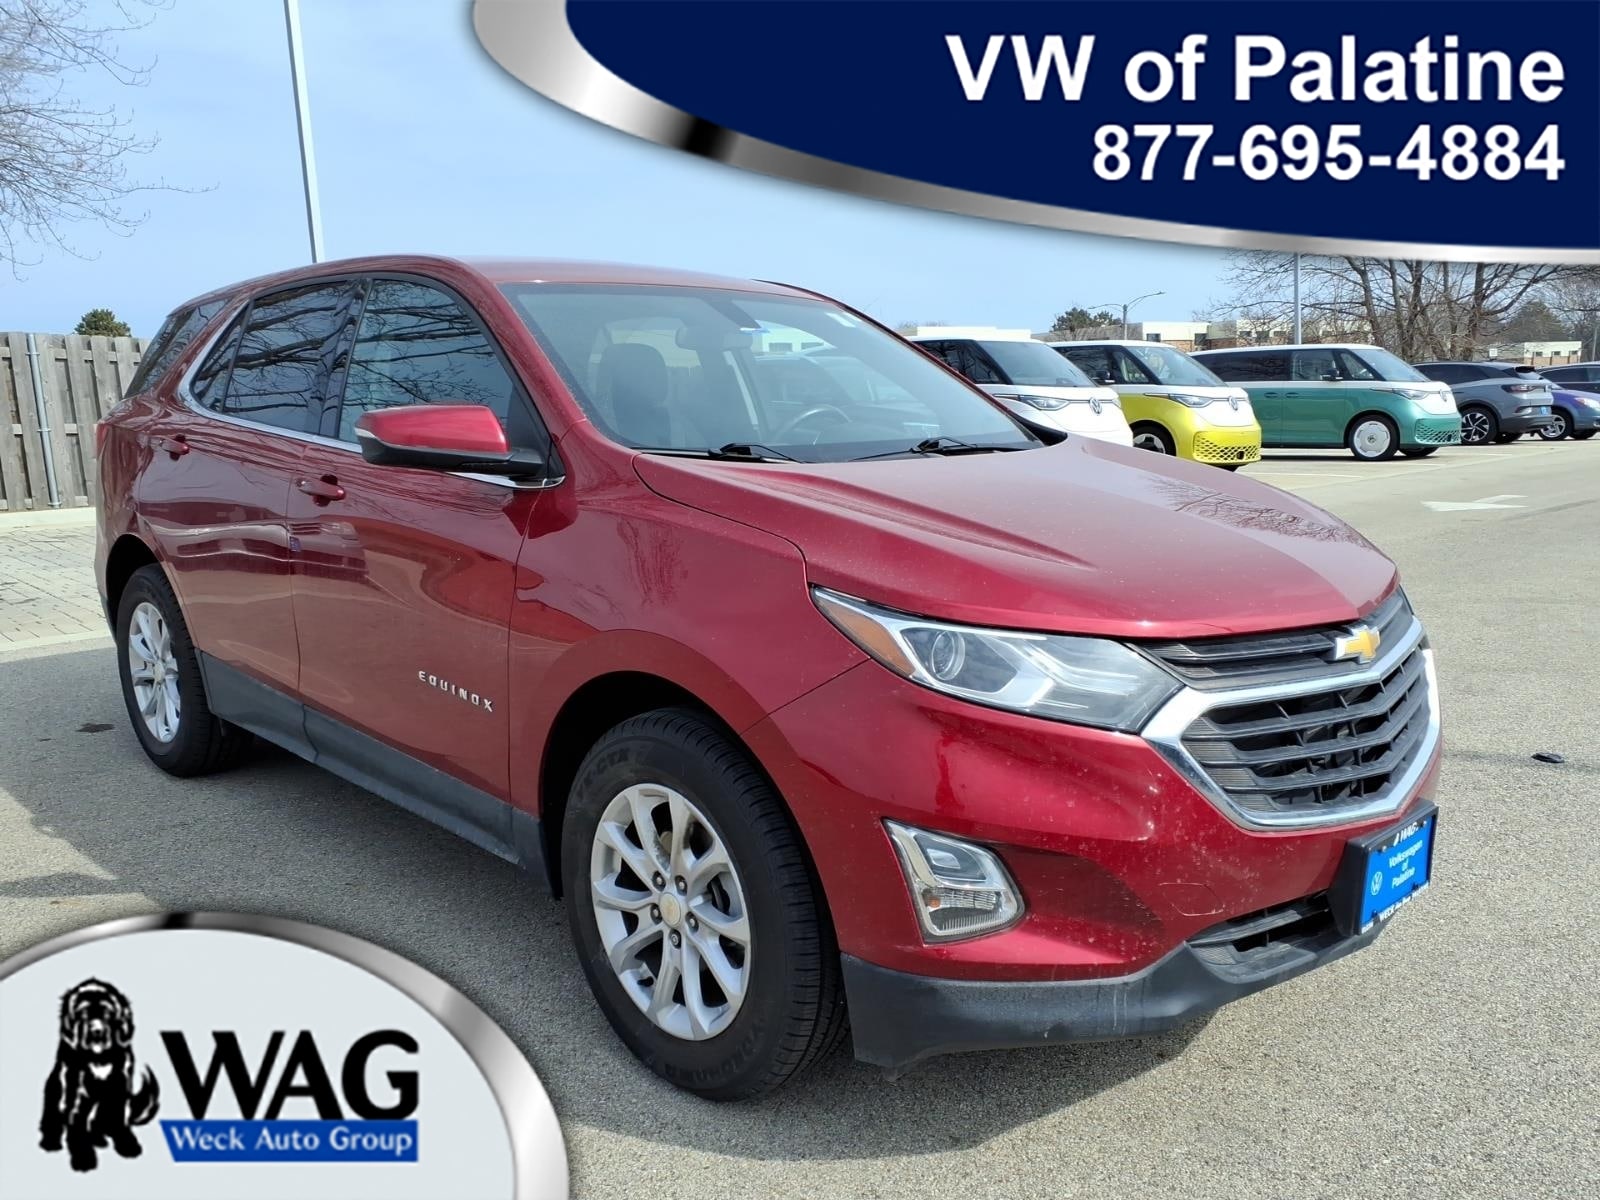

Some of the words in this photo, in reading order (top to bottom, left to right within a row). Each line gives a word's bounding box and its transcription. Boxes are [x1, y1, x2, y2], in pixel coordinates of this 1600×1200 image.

[418, 670, 493, 713] EQUINOX
[1389, 840, 1423, 868] Volkswagen
[1401, 858, 1409, 872] of
[1391, 867, 1416, 889] Palatine
